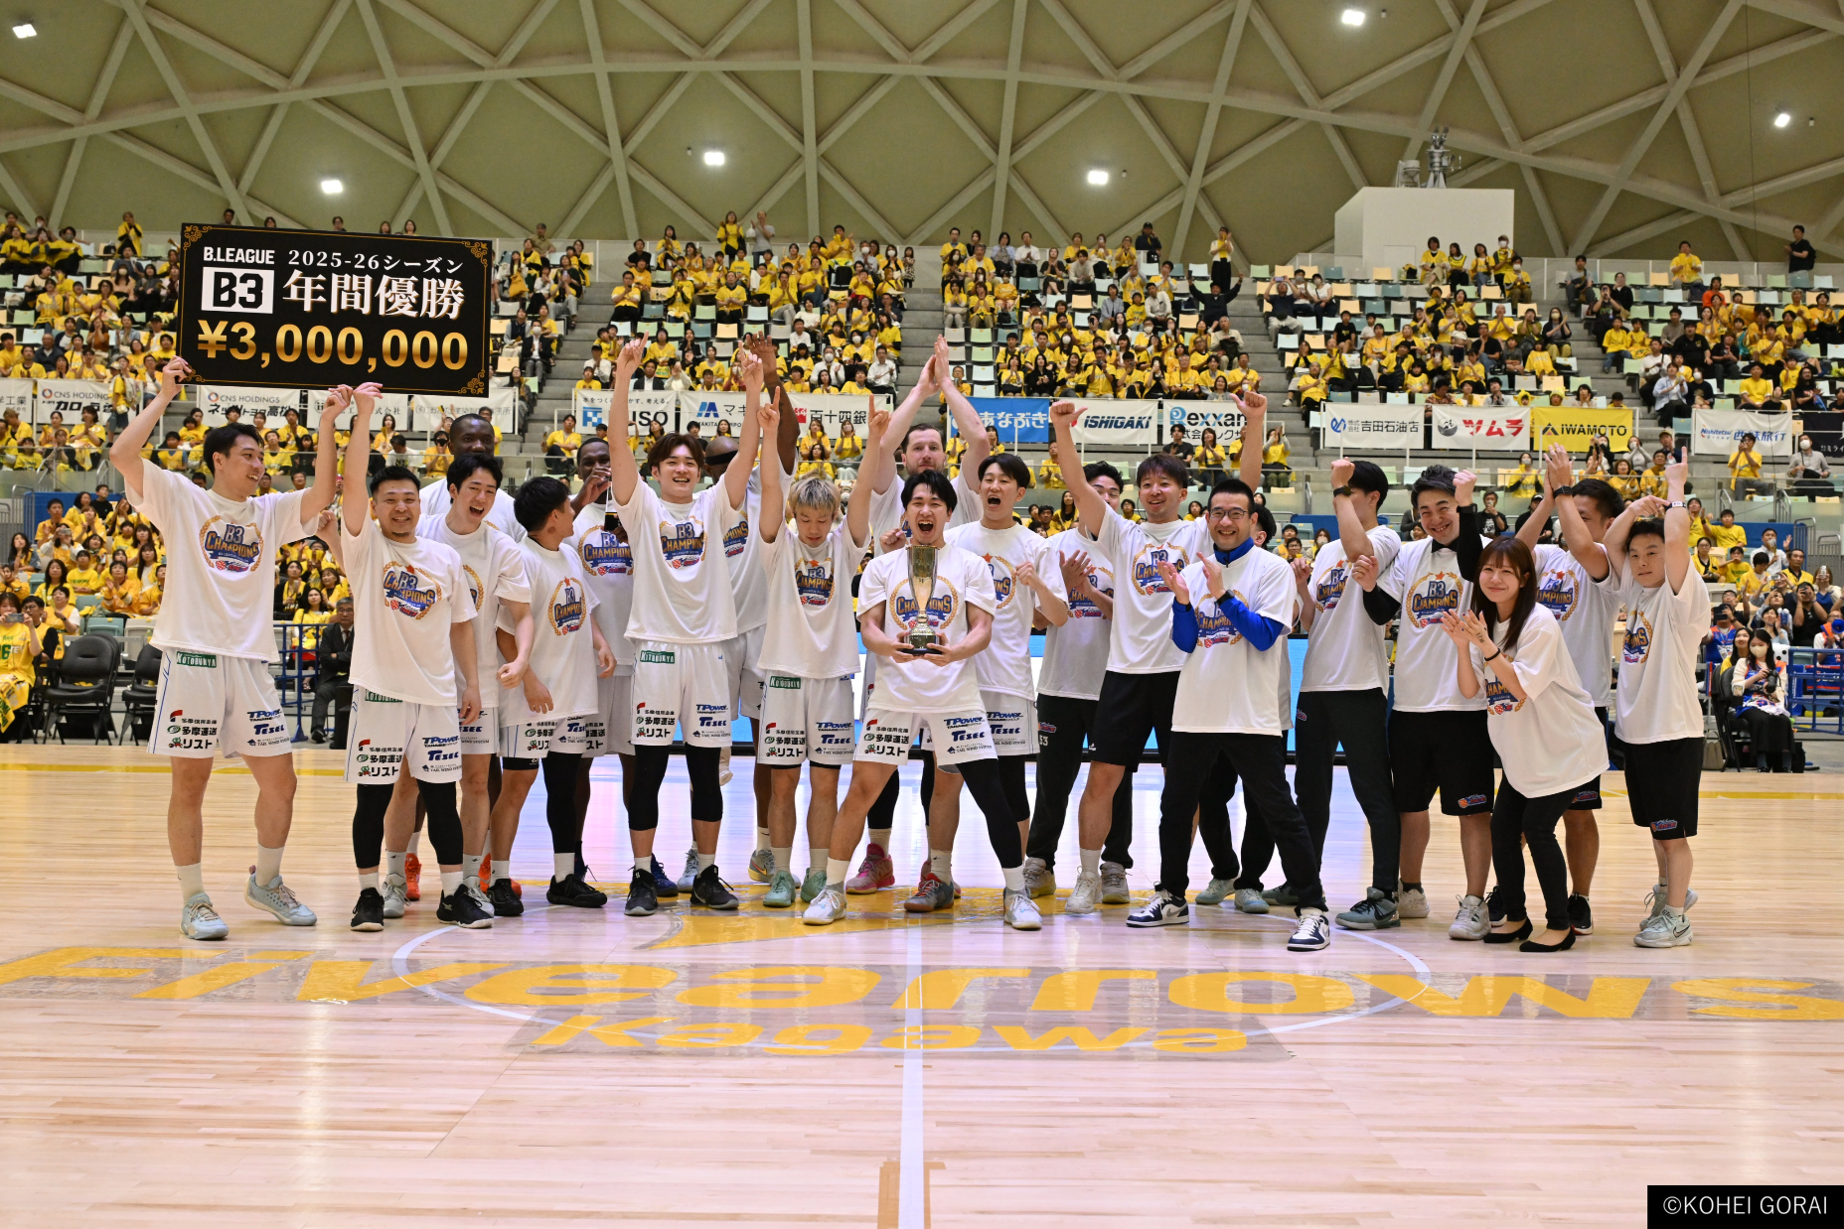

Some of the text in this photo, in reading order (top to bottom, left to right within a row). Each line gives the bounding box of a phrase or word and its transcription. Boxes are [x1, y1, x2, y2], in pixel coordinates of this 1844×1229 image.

[203, 246, 275, 265] B.LEAGUE
[288, 249, 464, 274] 2025-26シーズン
[212, 271, 265, 310] B3
[283, 268, 466, 320] 年間優勝
[197, 319, 469, 374] ¥3,000,000
[73, 392, 109, 401] HOLDING
[239, 395, 280, 404] HOLDINGS
[810, 409, 868, 425] 百十四銀
[1463, 418, 1525, 437] ツムラ
[225, 524, 245, 544] B3
[677, 523, 695, 539] B3
[602, 533, 617, 547] B3
[584, 543, 632, 561] CHAMPION
[401, 571, 418, 590] B3
[808, 567, 825, 579] B3
[1428, 581, 1446, 597] B3
[645, 717, 675, 725] 多摩運送
[182, 726, 217, 736] 多摩運送
[646, 728, 671, 738] リスト
[183, 739, 212, 749] リスト
[586, 741, 604, 750] スト
[776, 737, 806, 745] 多摩運送
[876, 735, 909, 744] 多摩運送
[777, 748, 803, 757] リスト
[876, 745, 906, 756] リスト
[371, 766, 399, 777] リスト
[0, 946, 1844, 1020] Fivearrows
[530, 1014, 1248, 1056] Kagawa
